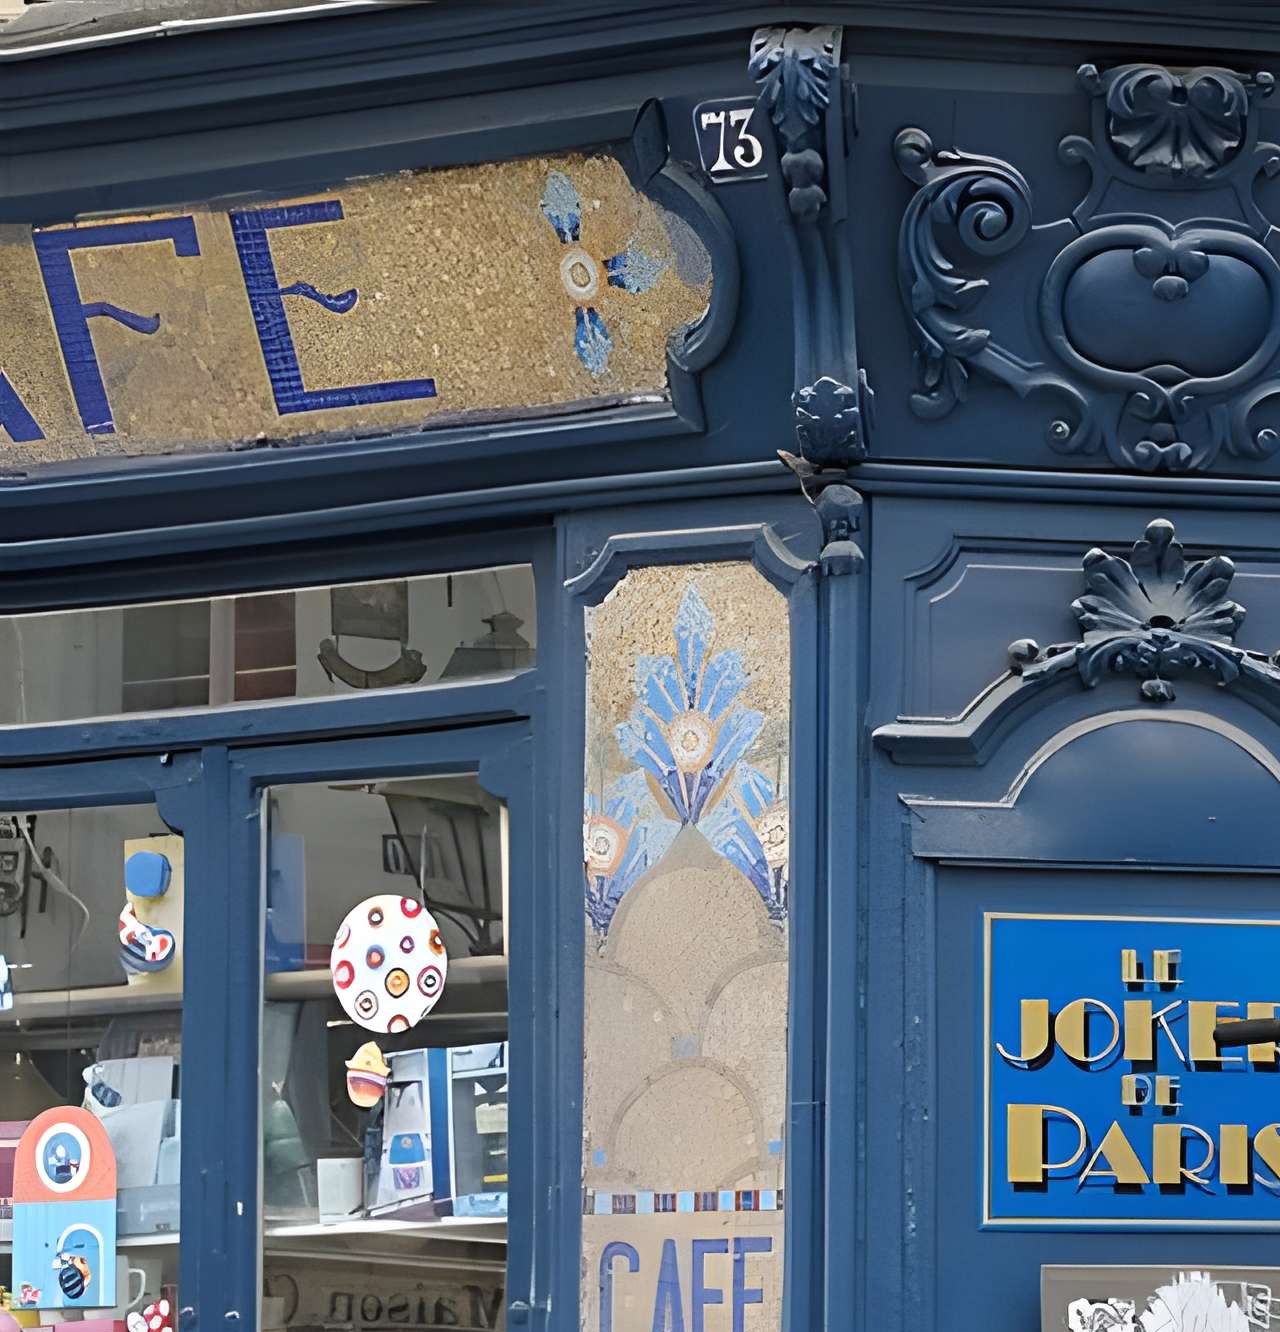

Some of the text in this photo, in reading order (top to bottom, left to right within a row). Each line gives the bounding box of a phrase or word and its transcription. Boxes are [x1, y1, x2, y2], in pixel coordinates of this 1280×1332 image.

[699, 106, 763, 173] 73
[0, 199, 437, 442] FE
[1120, 948, 1184, 986] LE
[1121, 1074, 1184, 1108] DE
